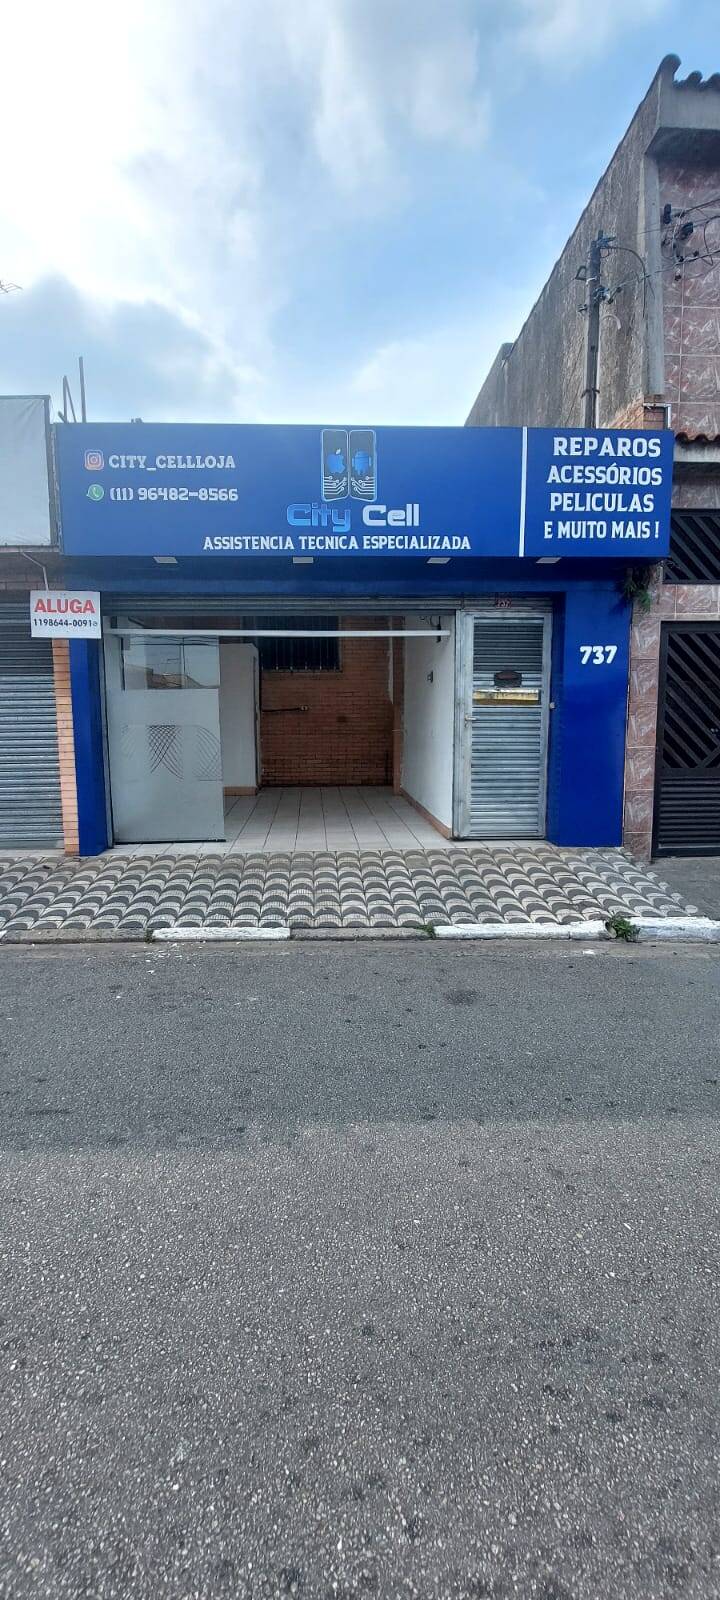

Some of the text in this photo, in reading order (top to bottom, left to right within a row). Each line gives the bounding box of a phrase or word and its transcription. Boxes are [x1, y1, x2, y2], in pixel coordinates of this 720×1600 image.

[553, 437, 661, 457] REPAROS
[108, 455, 236, 471] CITY_CELLLOJA
[546, 462, 663, 486] ACESSÓRIOS
[109, 487, 239, 501] (11) 96482-8566
[550, 492, 655, 513] PELICULAS
[286, 503, 420, 533] City Cell
[543, 521, 553, 539] E
[557, 521, 607, 539] MUITO
[203, 535, 471, 550] ASSISTENCIA TECNICA ESPECIALIZADA
[34, 598, 96, 614] ALUGA
[579, 645, 618, 665] 737
